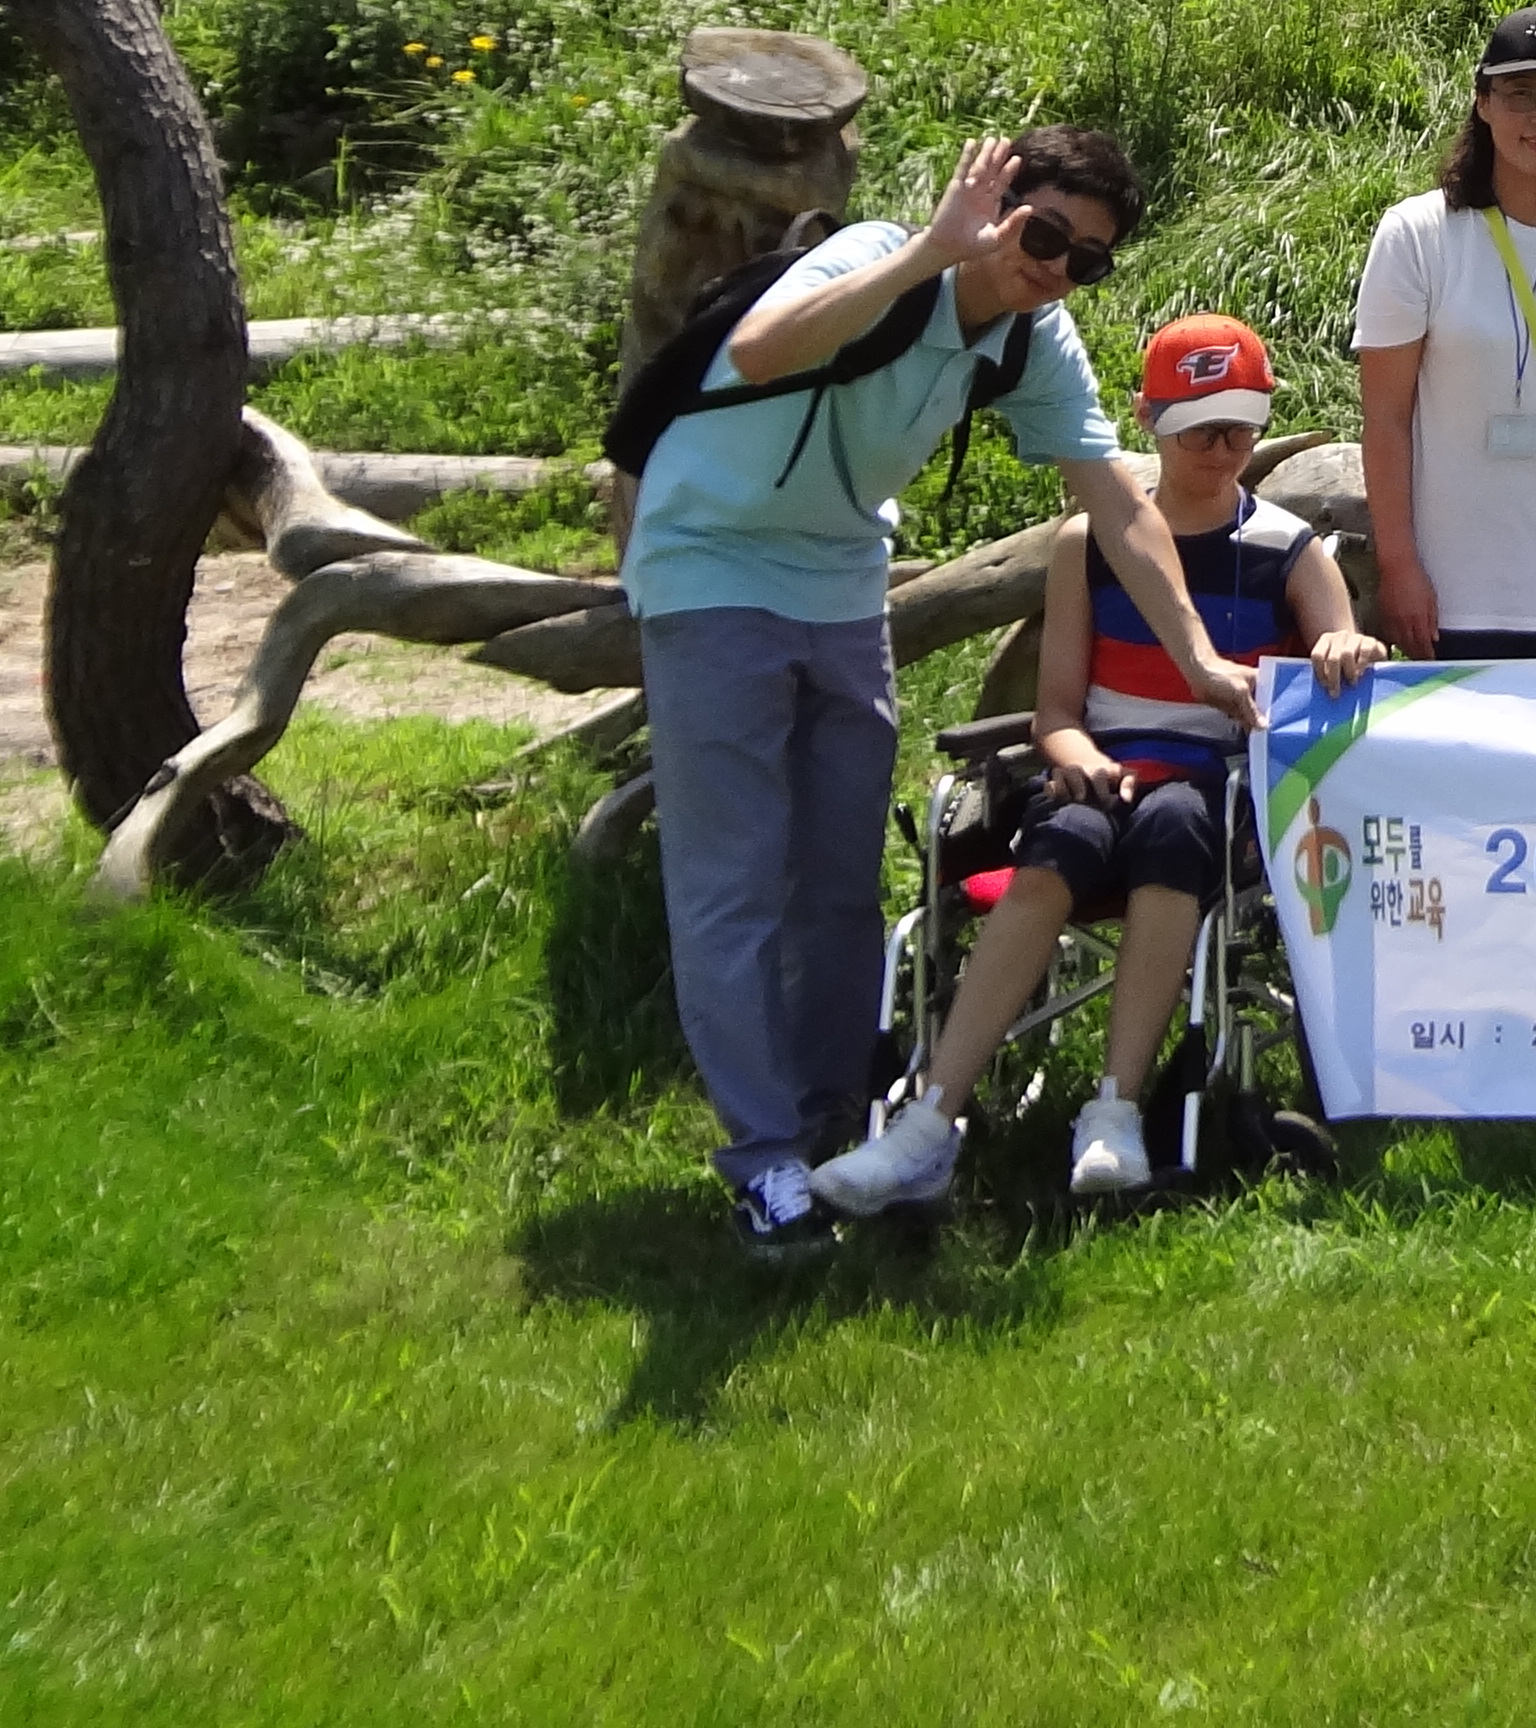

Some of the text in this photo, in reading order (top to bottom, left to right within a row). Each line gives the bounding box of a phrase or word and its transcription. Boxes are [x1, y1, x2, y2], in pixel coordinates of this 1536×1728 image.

[1362, 815, 1422, 873] 모두를
[1370, 877, 1445, 941] 위한 교육
[1411, 1021, 1465, 1050] 일시
